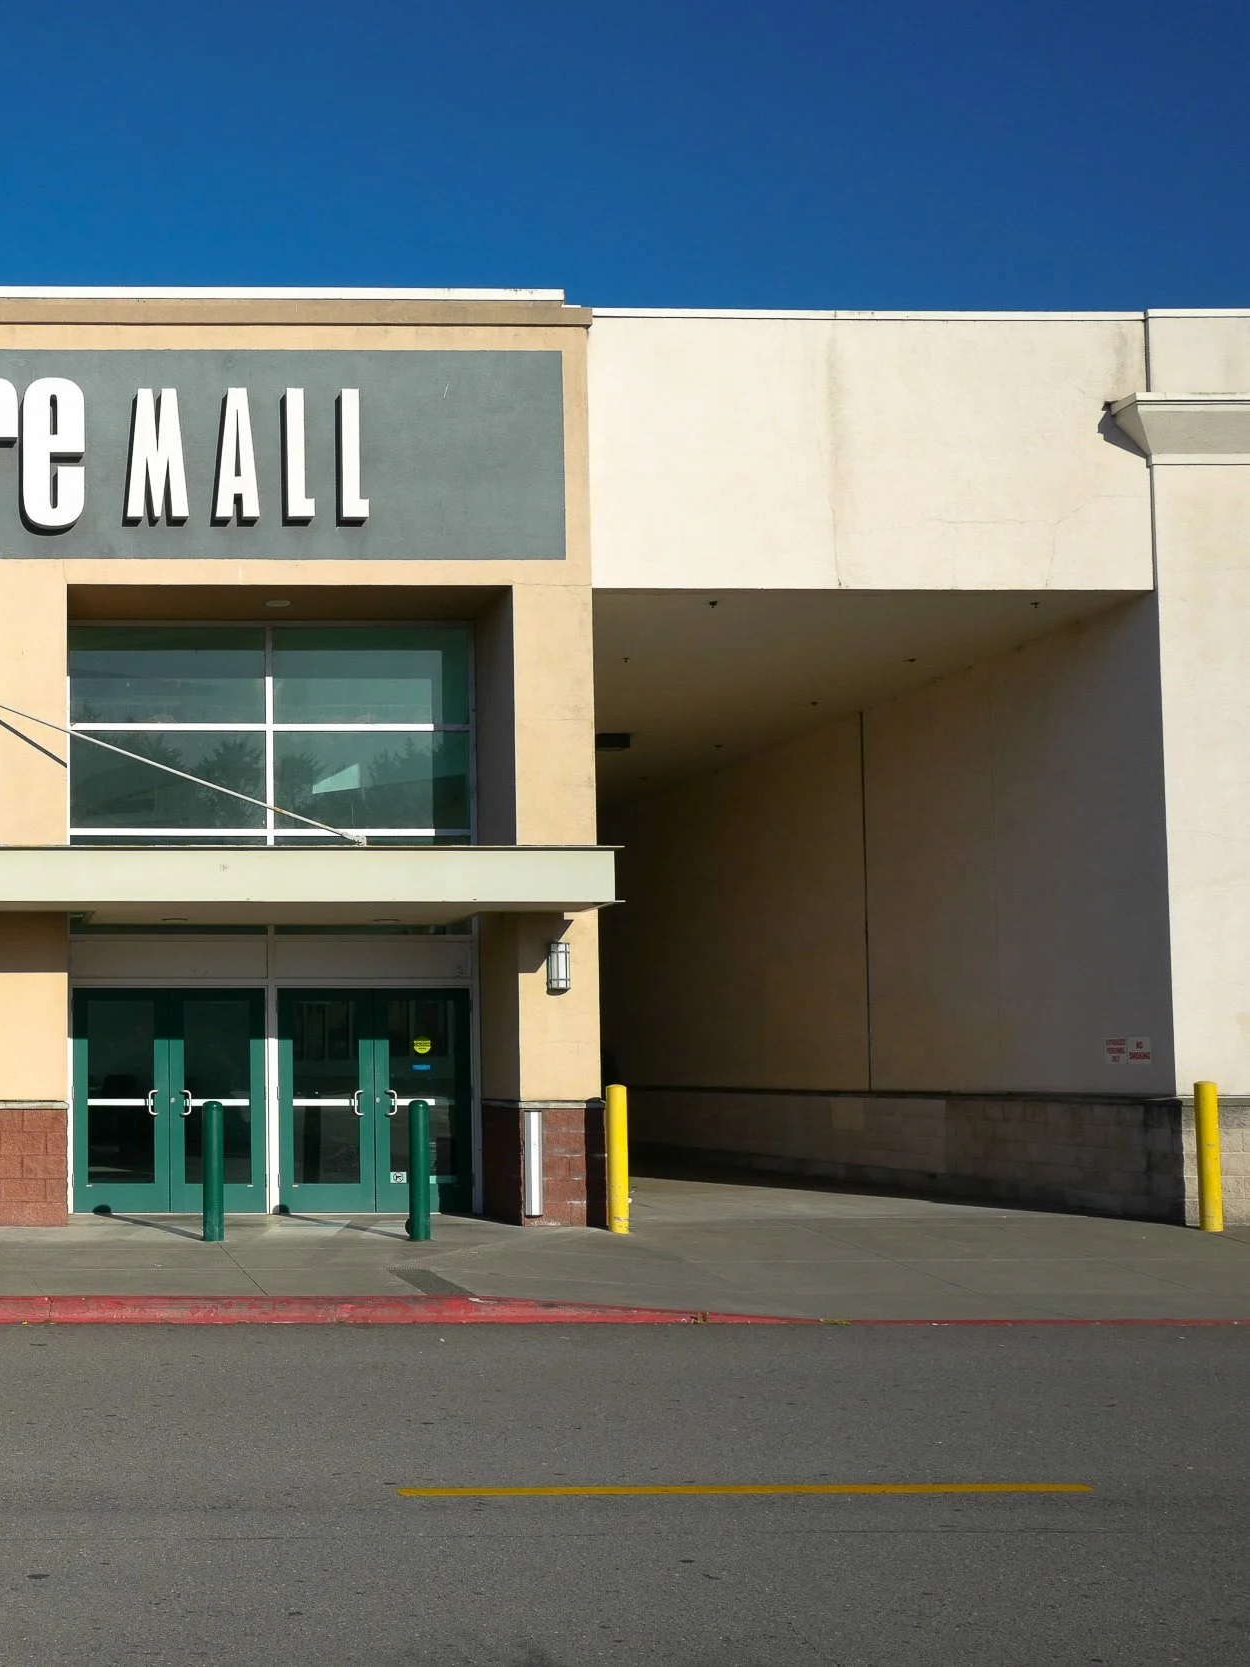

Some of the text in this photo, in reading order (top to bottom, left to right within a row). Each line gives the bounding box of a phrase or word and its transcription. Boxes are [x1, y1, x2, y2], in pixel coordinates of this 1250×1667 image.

[125, 387, 370, 519] MALL
[1136, 1041, 1143, 1049] NO
[1129, 1052, 1150, 1060] SMOKING
